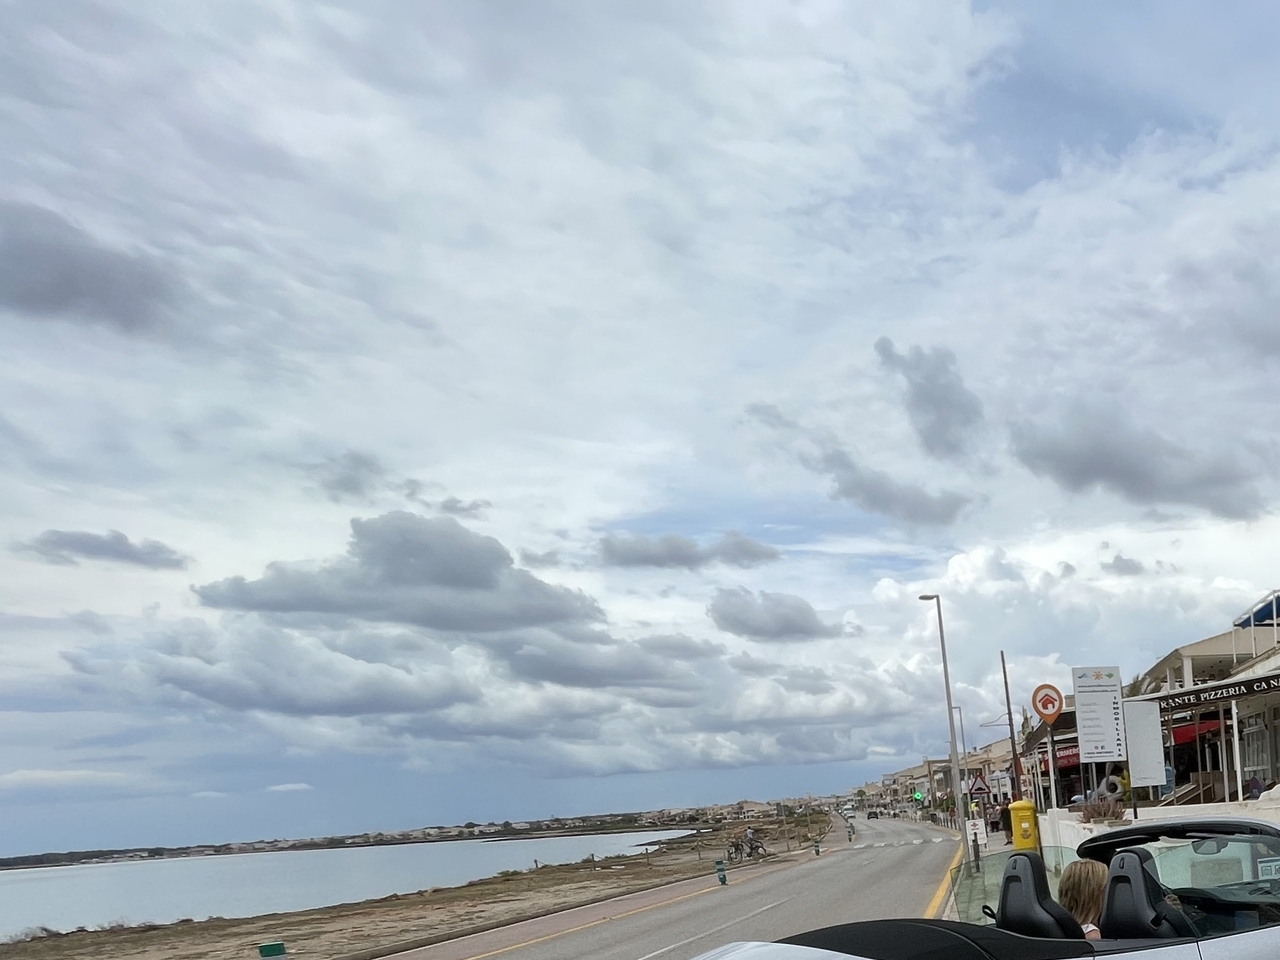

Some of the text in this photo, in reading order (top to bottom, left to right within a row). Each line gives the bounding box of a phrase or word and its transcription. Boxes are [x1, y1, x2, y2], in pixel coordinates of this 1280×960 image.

[1200, 686, 1248, 701] PIZZERIA
[1253, 683, 1268, 691] CA
[1112, 696, 1123, 757] INMOBILIARIA
